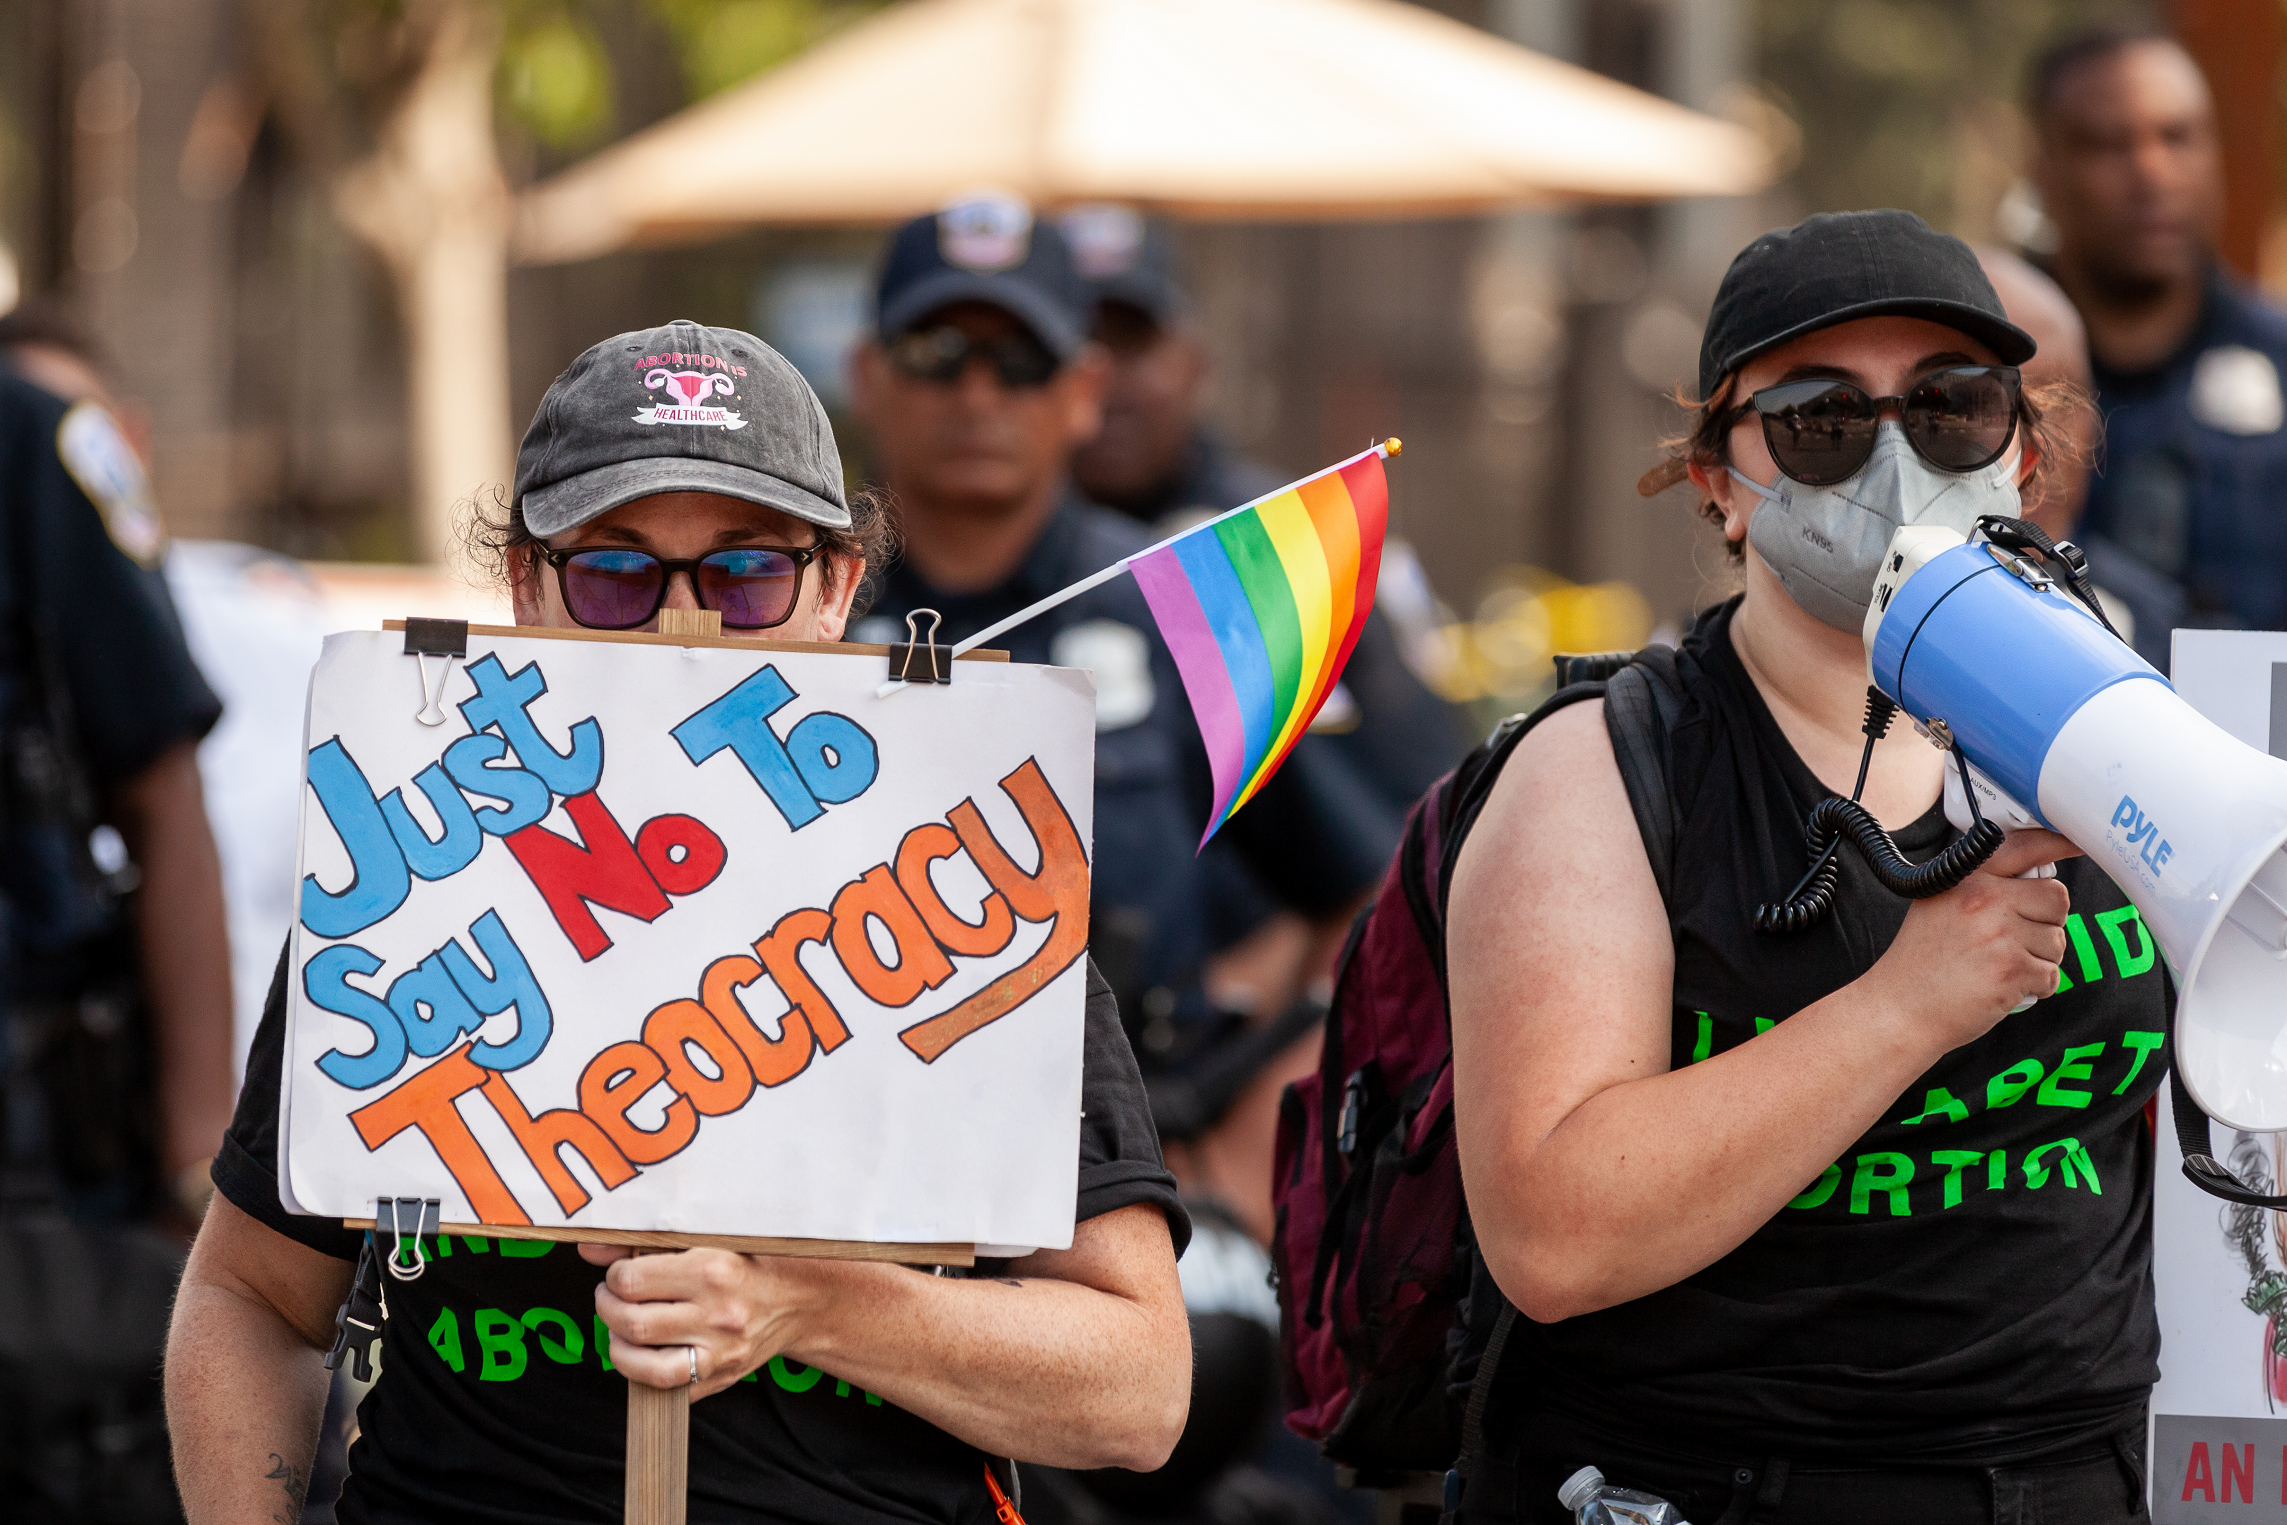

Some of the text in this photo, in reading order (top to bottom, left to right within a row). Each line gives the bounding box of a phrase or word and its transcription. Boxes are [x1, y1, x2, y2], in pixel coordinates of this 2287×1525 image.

[633, 352, 748, 378] ABORTION IS
[653, 407, 728, 422] HEALTHCARE
[1802, 525, 1834, 554] KN95
[300, 652, 605, 939] Just
[302, 663, 880, 1090] Say No To
[2055, 904, 2155, 994] ID
[348, 756, 1090, 1226] Theocracy
[2181, 1441, 2255, 1504] AN
